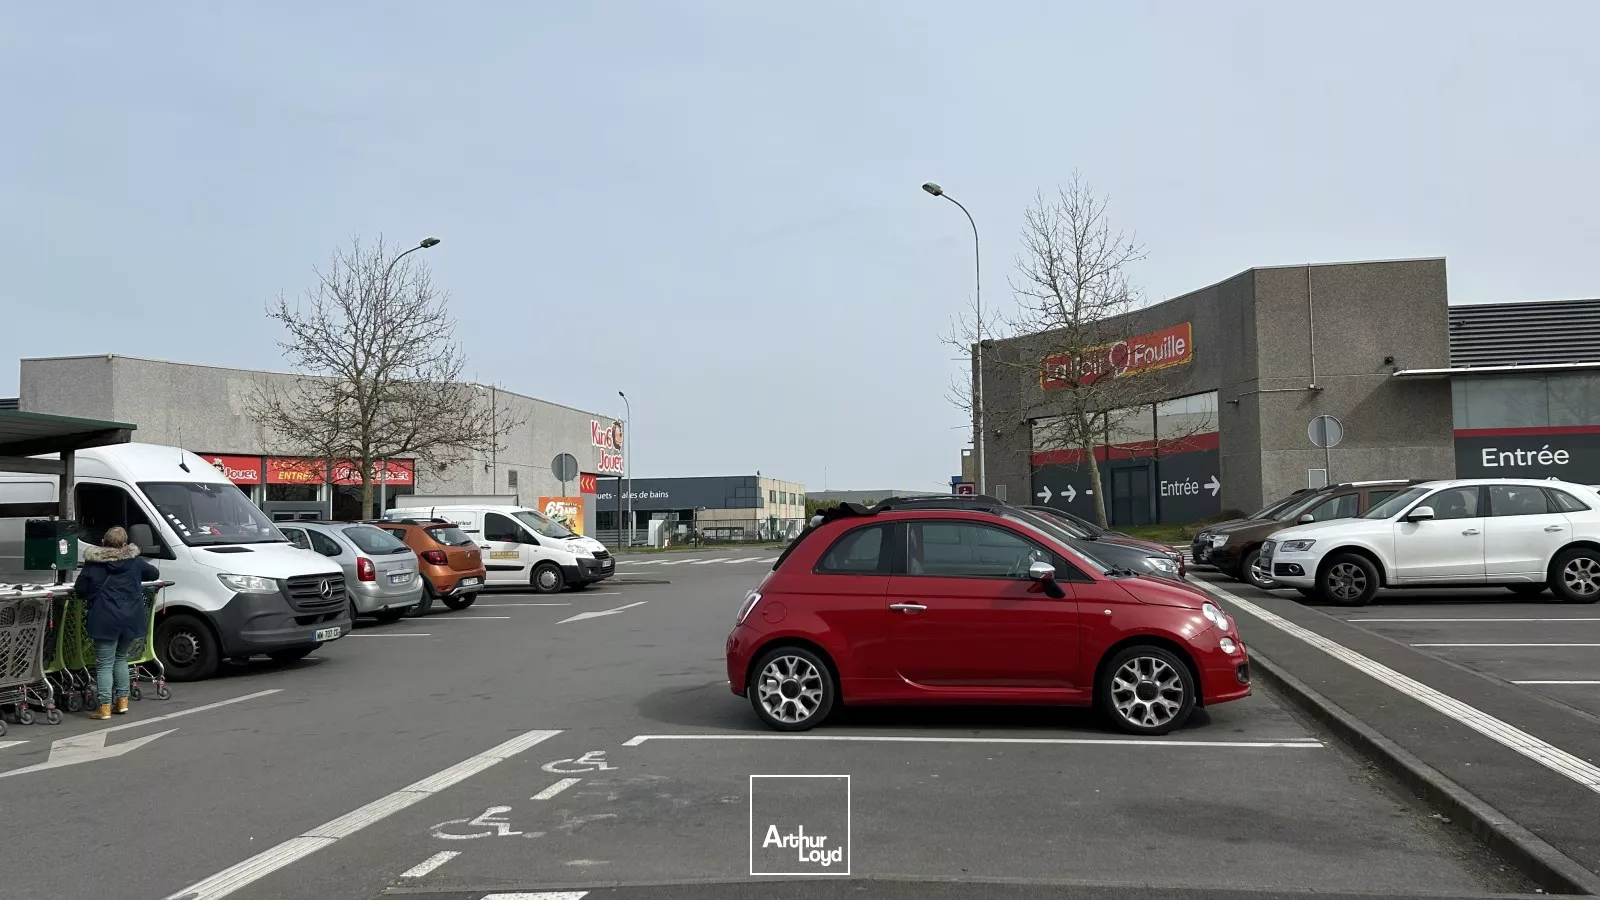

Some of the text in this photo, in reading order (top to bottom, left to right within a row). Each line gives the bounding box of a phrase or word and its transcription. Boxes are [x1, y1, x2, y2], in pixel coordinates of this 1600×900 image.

[1134, 335, 1186, 367] Fouille
[591, 420, 613, 449] King
[598, 448, 624, 473] Jouet
[1481, 444, 1570, 467] Entrée
[224, 467, 258, 480] Jouet
[639, 491, 648, 499] de
[650, 490, 669, 498] bains
[1160, 477, 1199, 496] Entrée
[545, 501, 565, 518] 65
